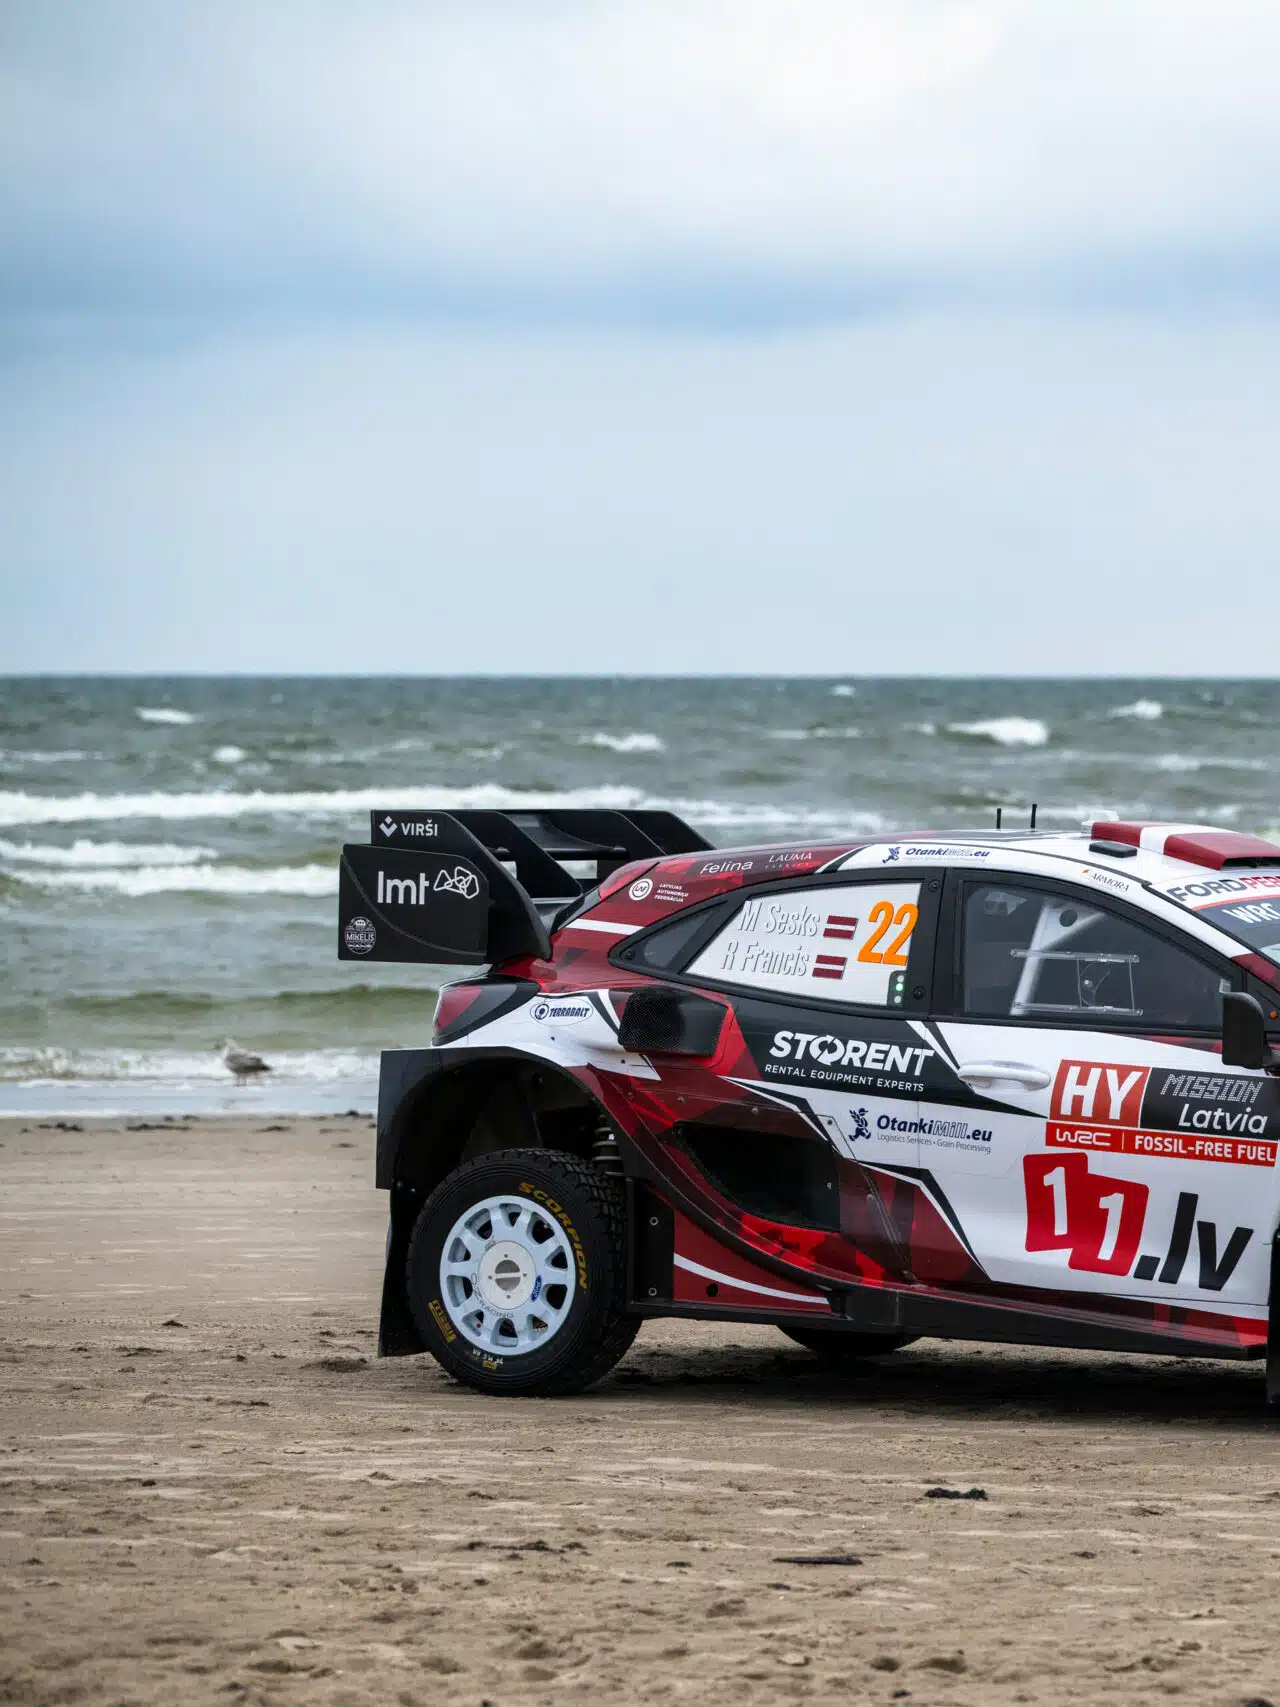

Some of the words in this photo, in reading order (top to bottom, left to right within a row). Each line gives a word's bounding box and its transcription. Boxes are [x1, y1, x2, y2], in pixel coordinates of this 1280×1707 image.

[401, 819, 438, 837] VIRŠI
[768, 852, 813, 863] LAUMA
[377, 871, 430, 905] lmt
[1092, 872, 1129, 891] ARMORA
[737, 901, 763, 932] M
[765, 903, 821, 937] Sesks
[857, 900, 919, 966] 22
[721, 939, 739, 970] R
[740, 941, 811, 977] Francis
[549, 1005, 591, 1018] TERRABALT
[769, 1031, 935, 1076] STORENT
[764, 1064, 806, 1077] RENTAL
[810, 1069, 874, 1087] EQUIPMENT
[877, 1078, 924, 1092] EXPERTS
[1059, 1065, 1144, 1120] HY
[1160, 1073, 1264, 1104] MISSION
[877, 1115, 993, 1142] OtankiMill.eu
[1178, 1103, 1268, 1134] Latvia
[877, 1132, 905, 1144] Logistics
[955, 1141, 992, 1154] Processing
[1055, 1128, 1111, 1147] WRC
[1134, 1135, 1234, 1159] FOSSIL-FREE
[1237, 1144, 1275, 1162] FUEL
[519, 1182, 588, 1289] SCORPION
[1043, 1166, 1254, 1291] 11.lv
